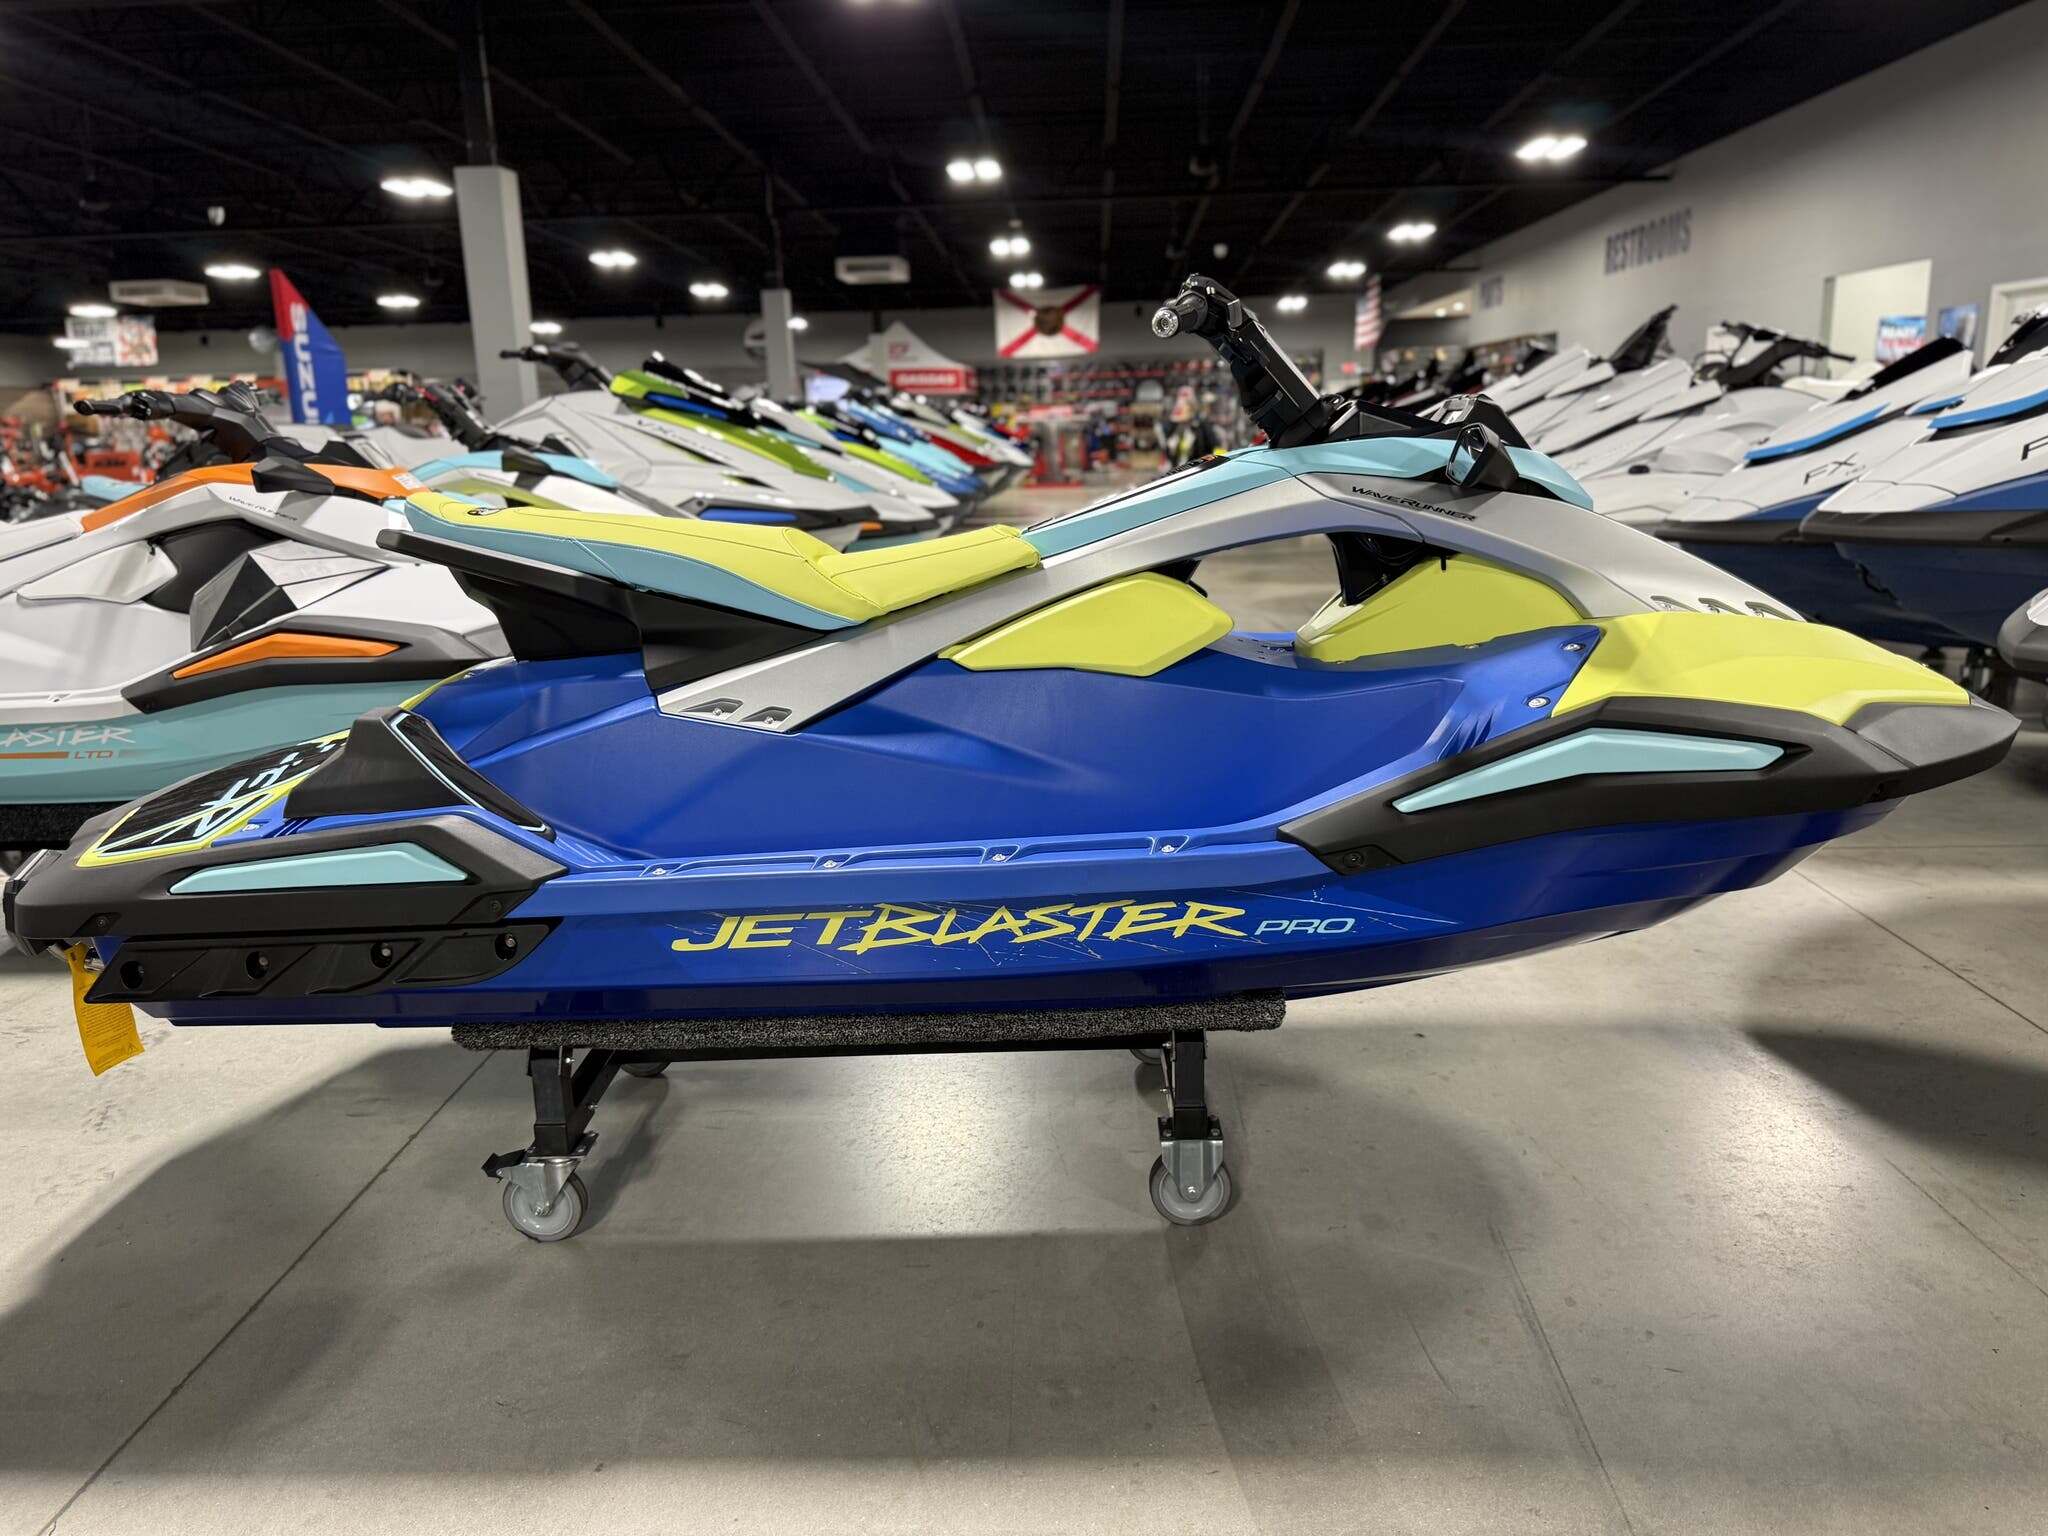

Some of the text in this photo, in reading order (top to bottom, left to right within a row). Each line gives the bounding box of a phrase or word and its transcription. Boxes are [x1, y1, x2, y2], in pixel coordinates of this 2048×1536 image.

[1604, 207, 1691, 275] RESTROOMS
[290, 302, 320, 424] SUZU
[1803, 452, 1859, 485] FX
[1352, 486, 1476, 521] WAVERUNNER
[0, 725, 136, 748] ASTER
[74, 750, 114, 760] LTD
[1254, 916, 1357, 936] PRO
